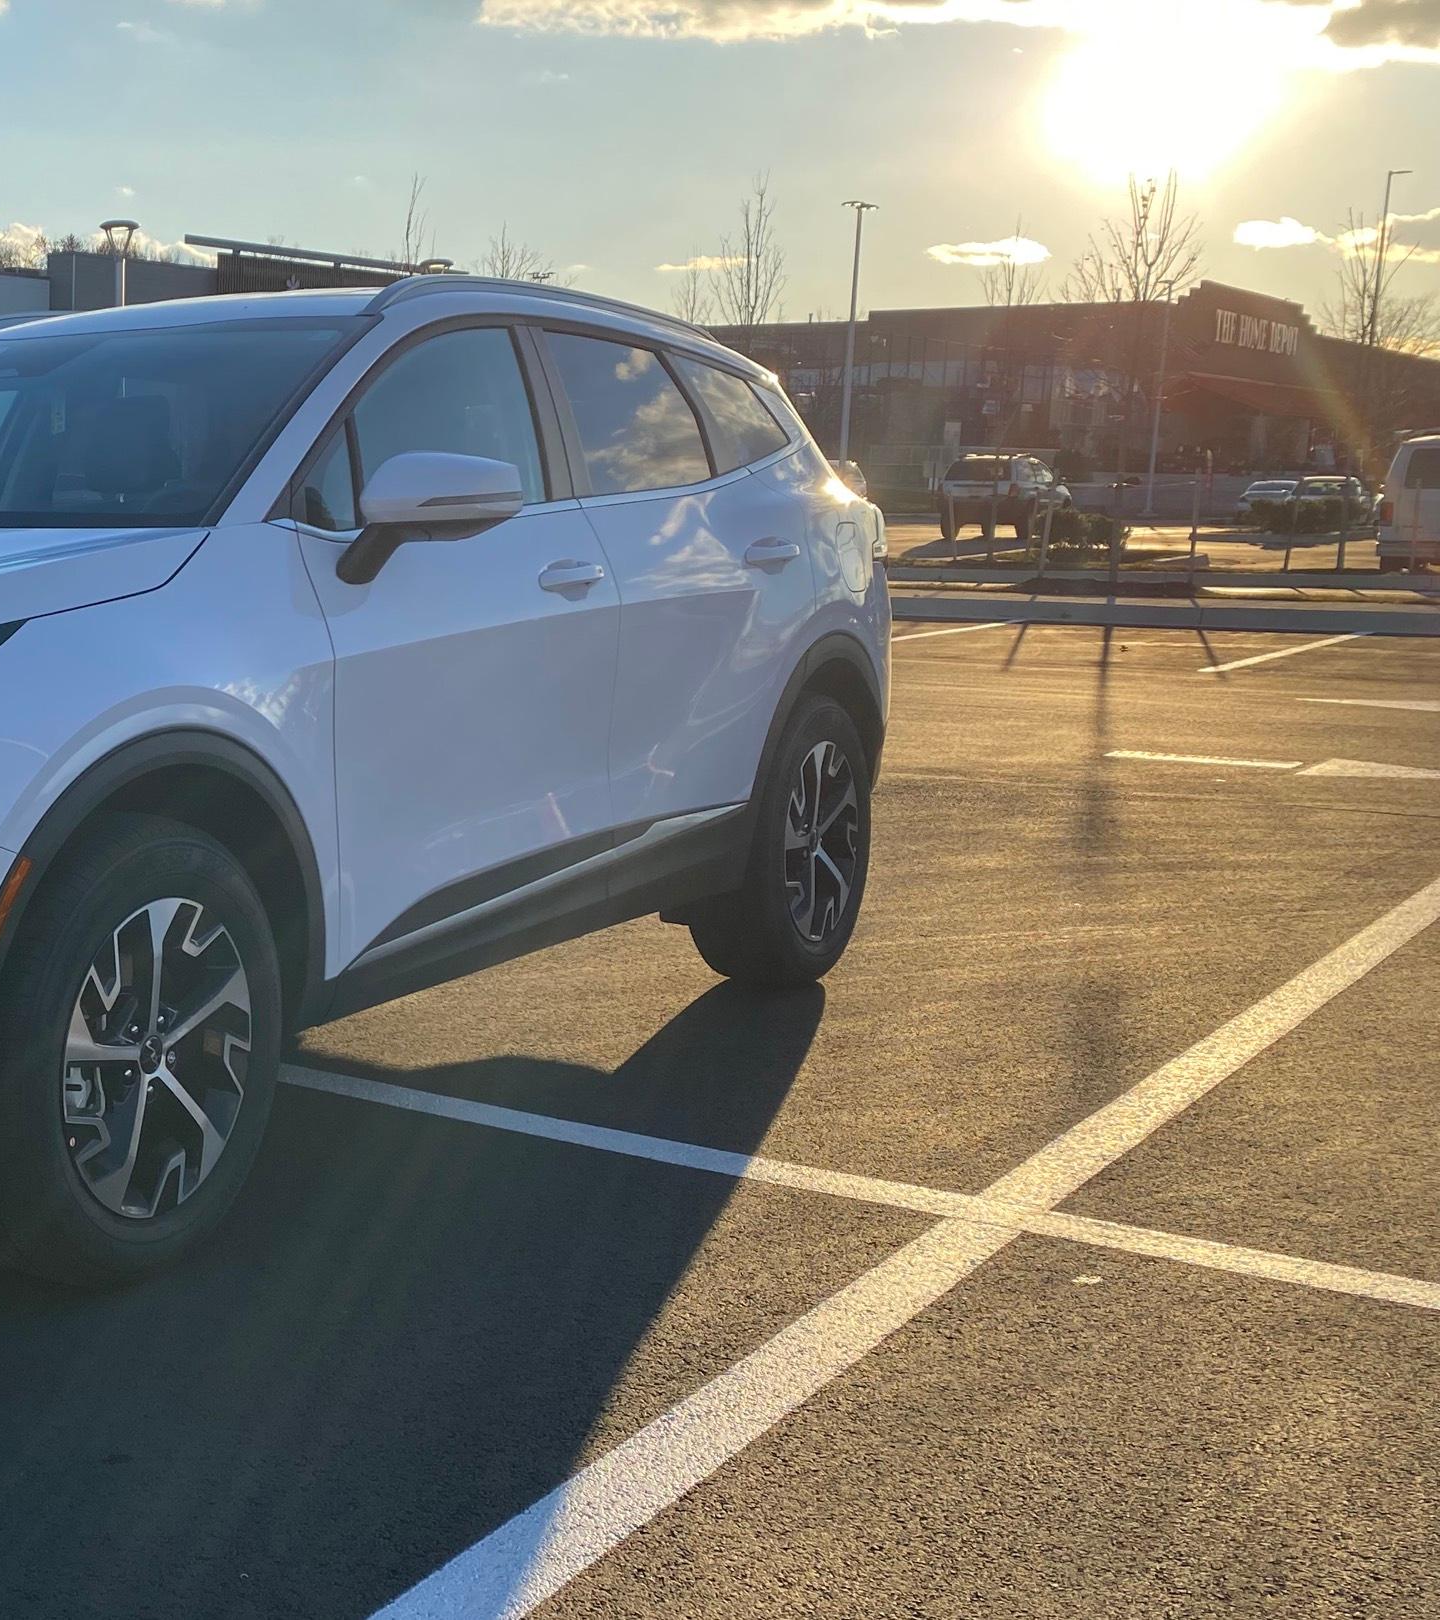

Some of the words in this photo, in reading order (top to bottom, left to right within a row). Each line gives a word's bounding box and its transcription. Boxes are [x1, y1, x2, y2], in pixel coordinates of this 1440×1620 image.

[1215, 308, 1237, 344] THE
[1238, 314, 1268, 350] HOME
[1269, 321, 1299, 356] DEPOT
